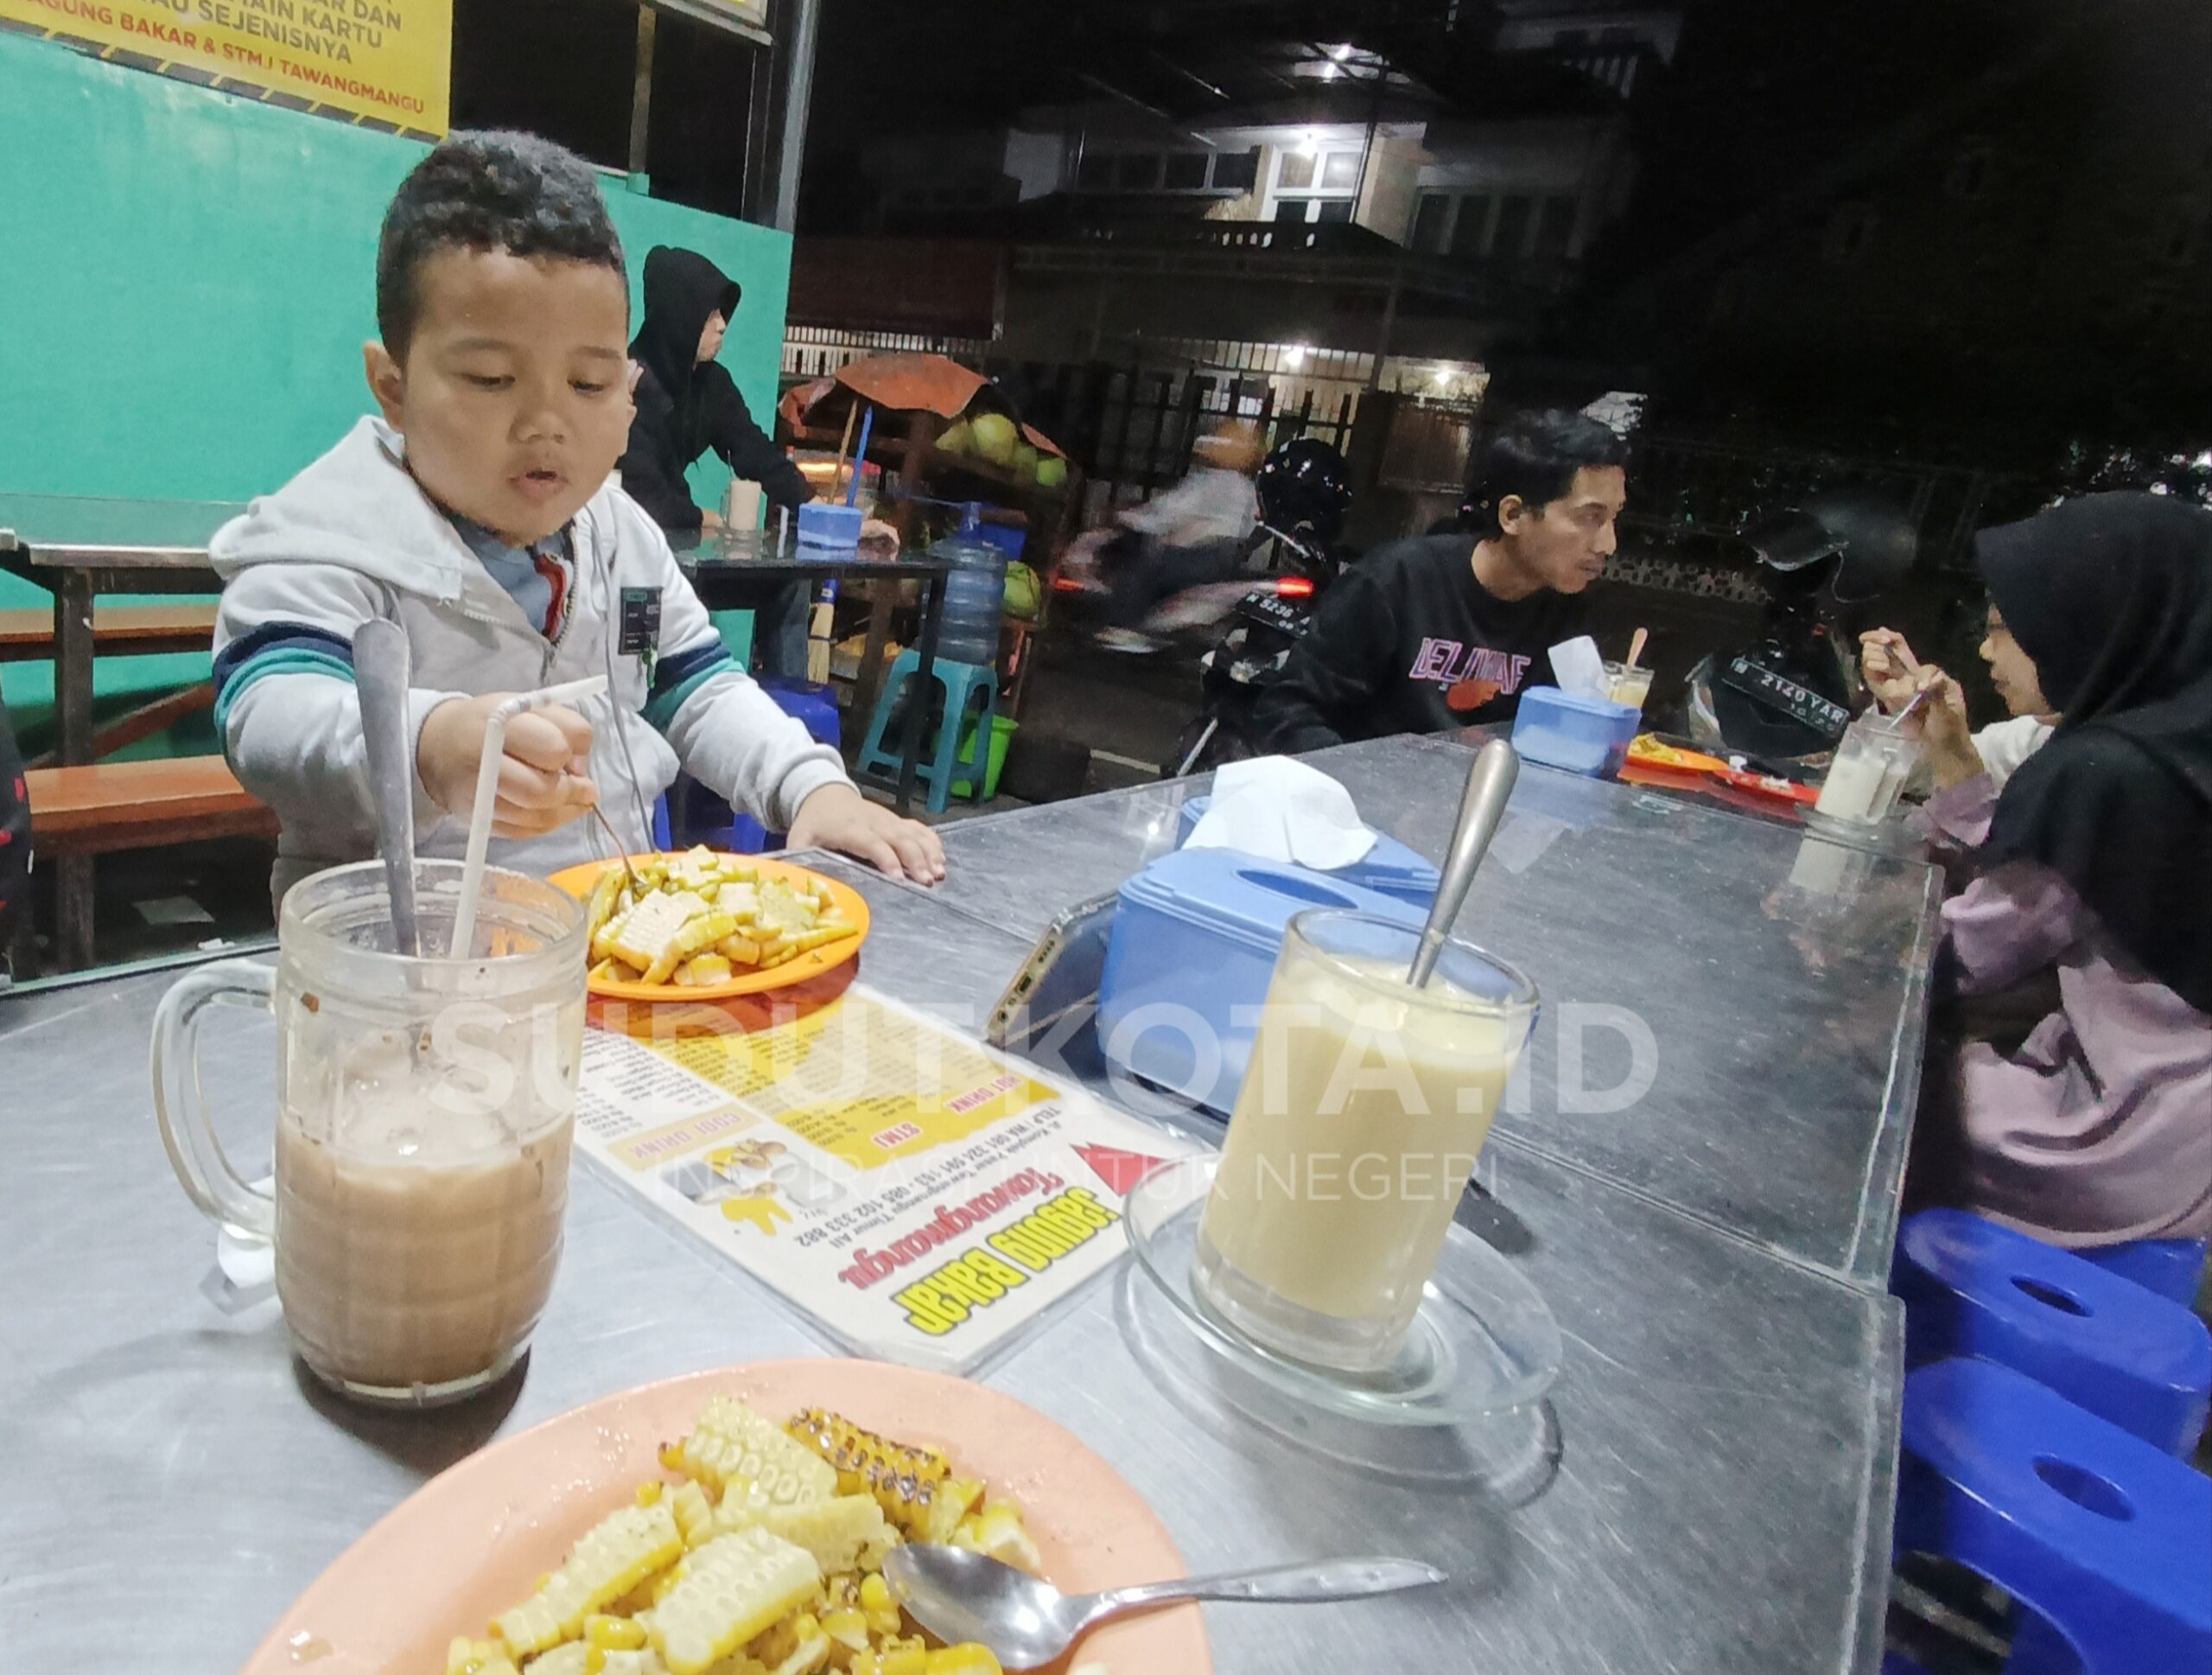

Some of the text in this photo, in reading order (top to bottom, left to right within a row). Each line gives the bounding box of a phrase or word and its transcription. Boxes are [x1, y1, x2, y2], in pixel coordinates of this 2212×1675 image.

[199, 0, 353, 64] SEJENISNYA
[243, 0, 382, 48] AIN KARTU
[353, 0, 402, 32] DAN
[120, 12, 196, 49] BAKAR
[203, 36, 215, 54] &
[280, 59, 424, 114] TAWANGMANGU
[946, 1086, 995, 1113] DRINK
[1033, 1106, 1062, 1125] TELP
[837, 1167, 1065, 1290] Tawangmangu
